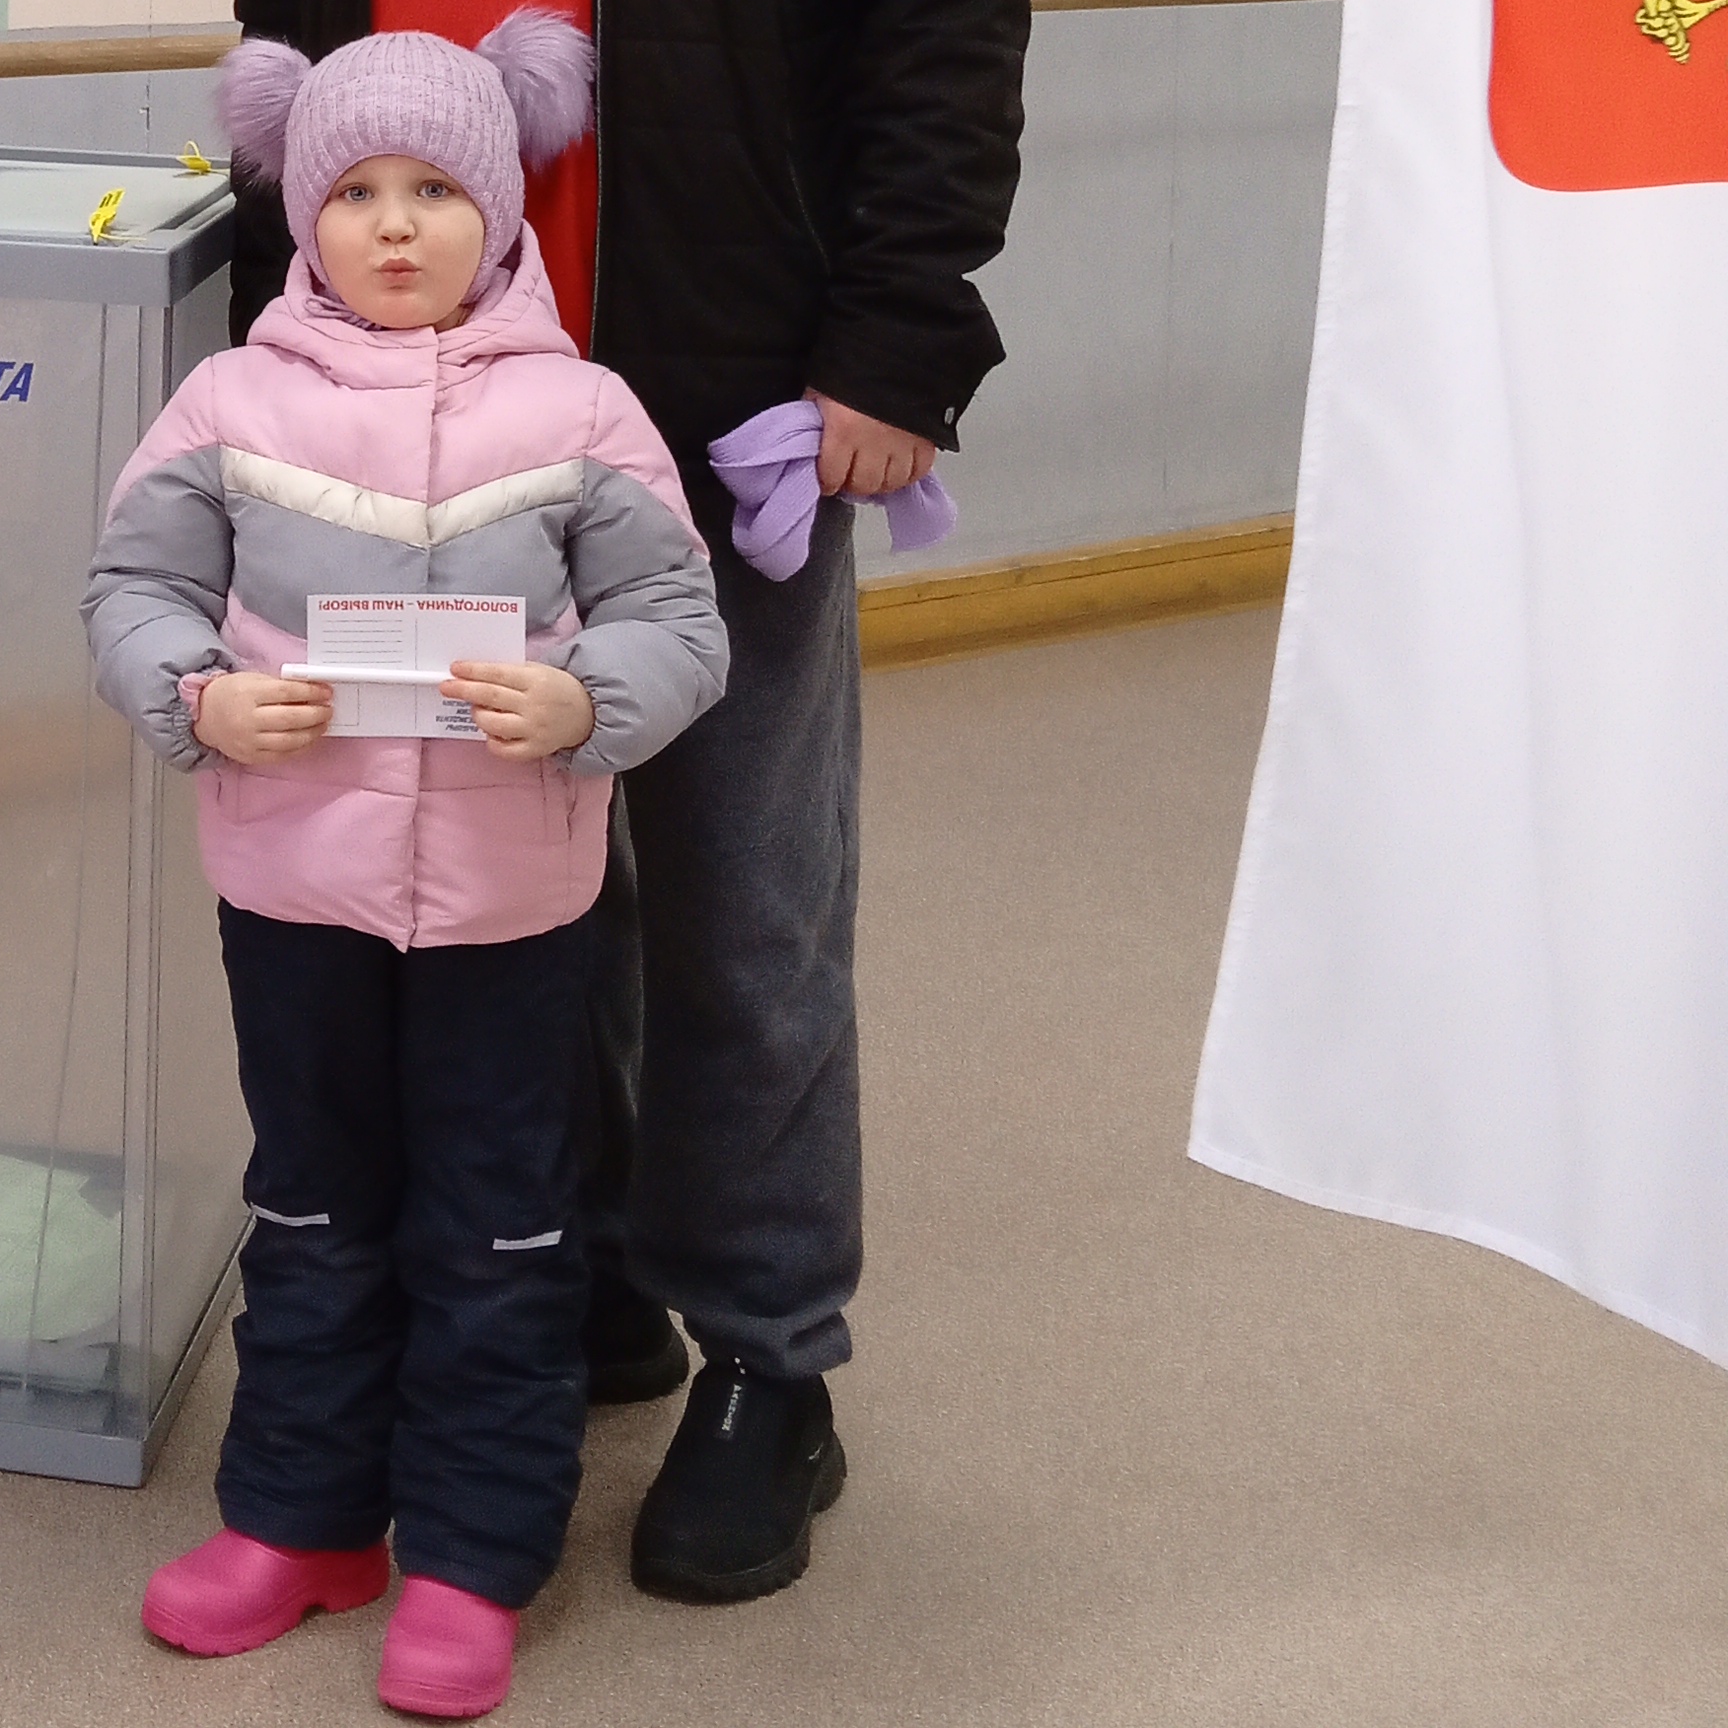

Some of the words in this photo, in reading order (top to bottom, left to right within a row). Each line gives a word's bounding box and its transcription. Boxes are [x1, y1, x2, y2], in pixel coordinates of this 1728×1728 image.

[318, 599, 370, 611] ВЫБОР!
[372, 599, 405, 611] НАШ
[416, 598, 519, 613] ВОЛОГОДЧИНА
